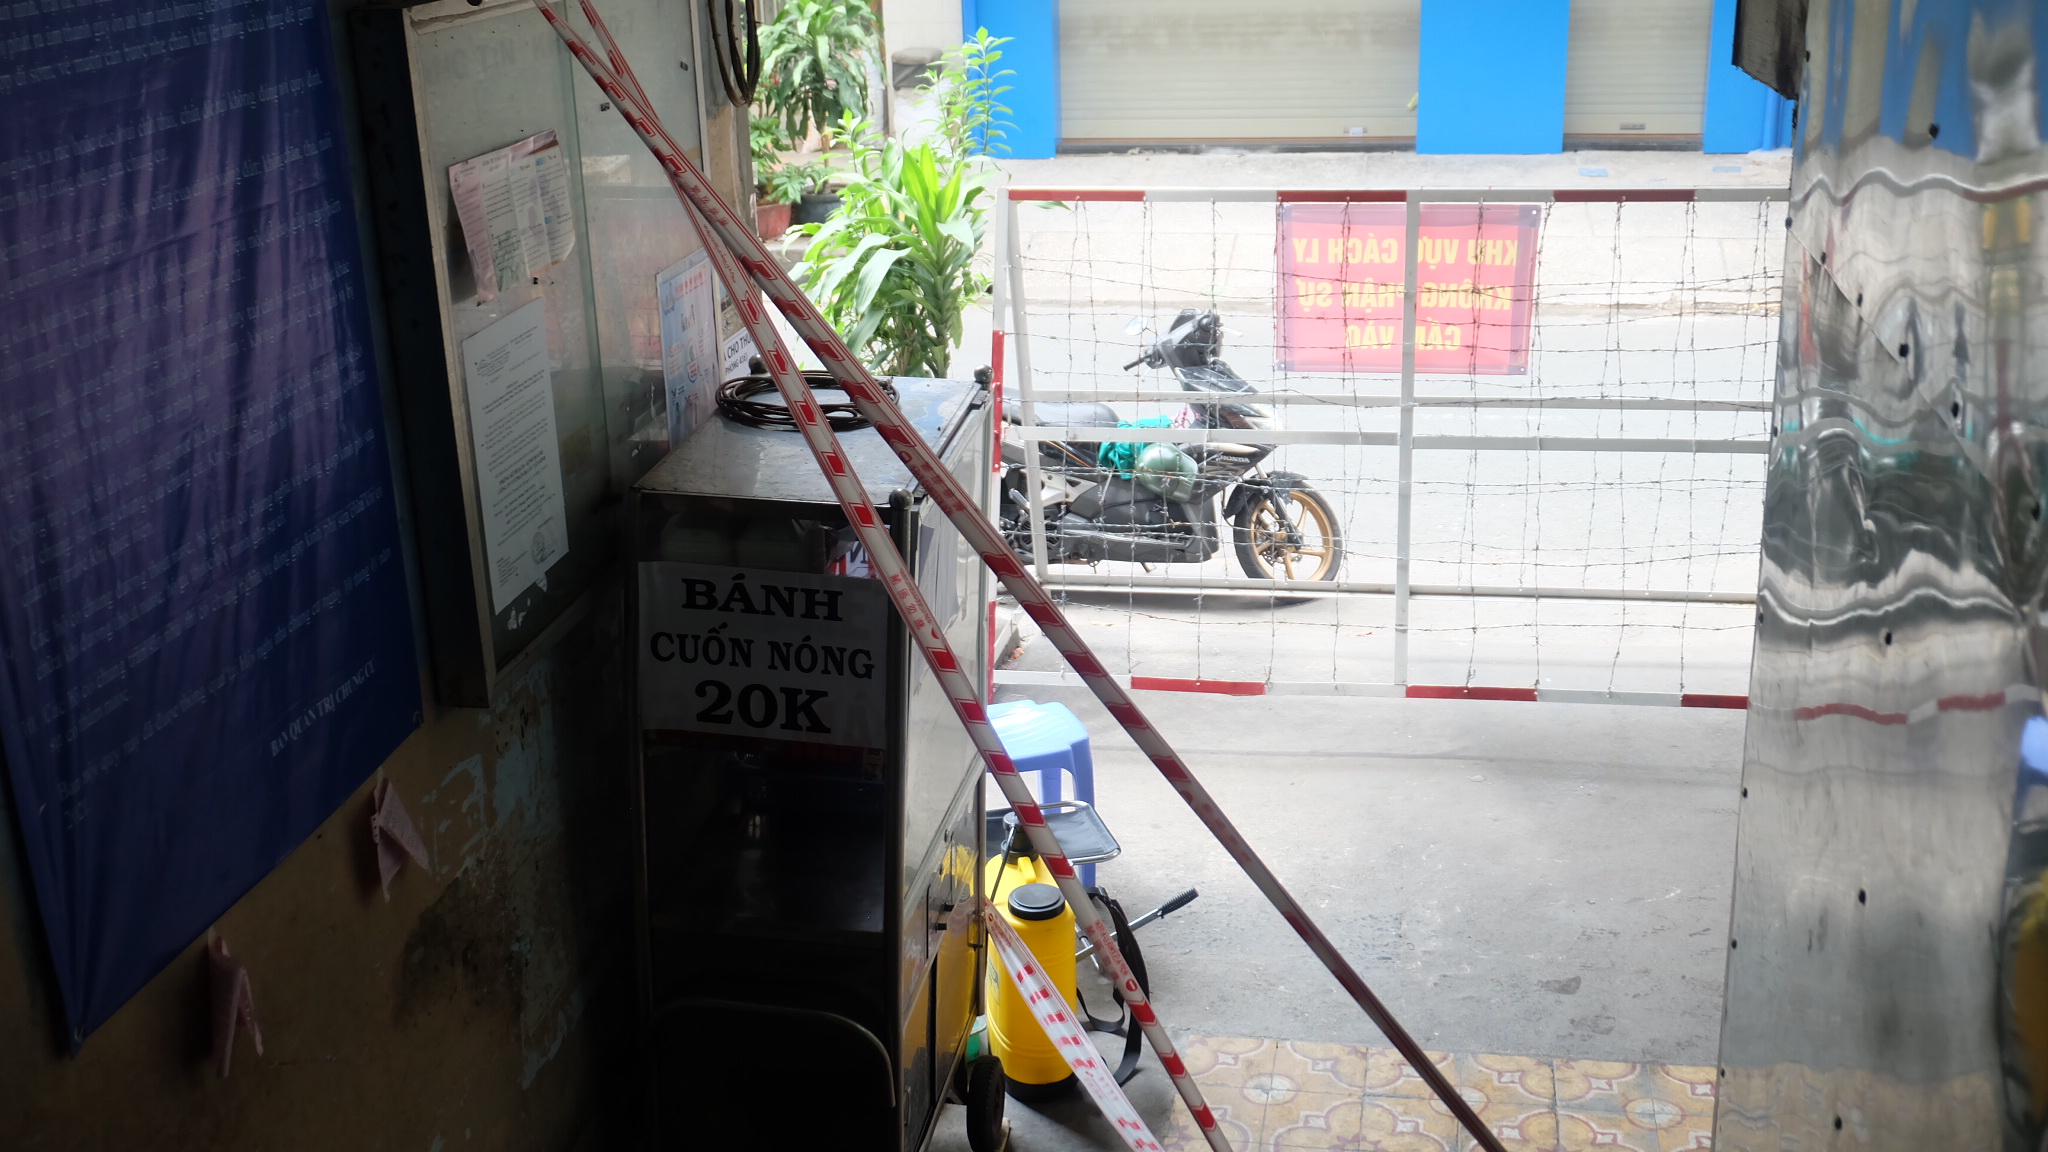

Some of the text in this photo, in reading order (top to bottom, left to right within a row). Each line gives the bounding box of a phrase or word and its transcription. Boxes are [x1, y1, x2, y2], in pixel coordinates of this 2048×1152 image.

[727, 341, 739, 359] CHO
[1220, 455, 1250, 463] HONDA
[681, 573, 843, 622] BÁNH
[650, 622, 875, 680] CUỐN NÓNG
[695, 680, 831, 734] 20K
